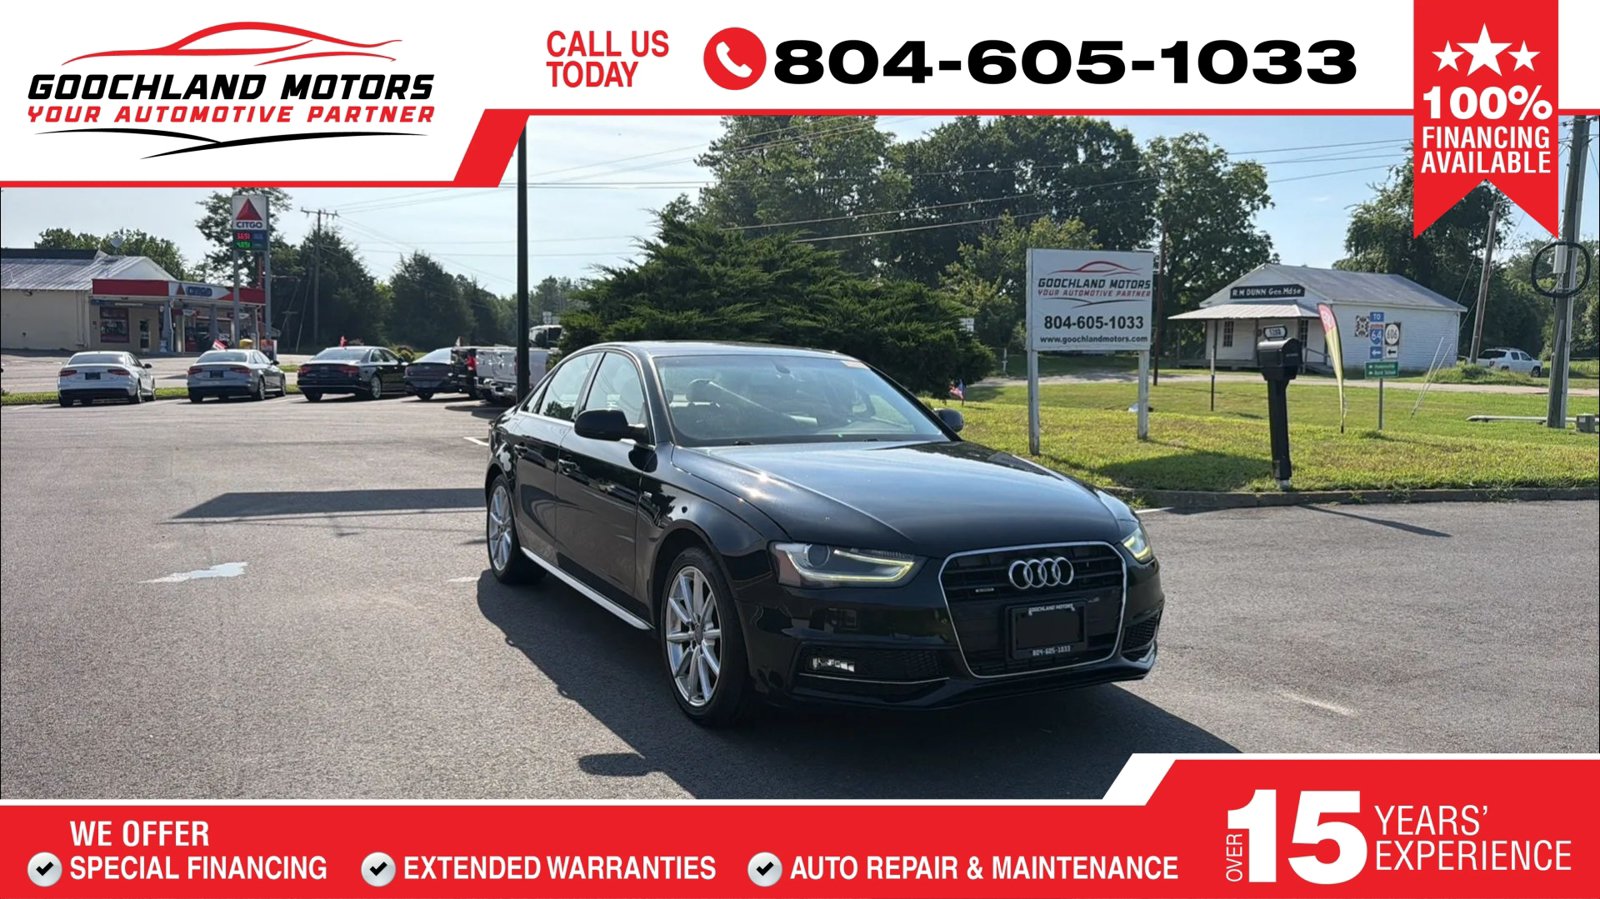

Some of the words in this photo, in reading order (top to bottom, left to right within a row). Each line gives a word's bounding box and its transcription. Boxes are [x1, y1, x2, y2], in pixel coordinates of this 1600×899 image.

[236, 221, 263, 229] CITGO
[1037, 278, 1105, 288] GOOCHLAND
[1109, 279, 1151, 289] MOTORS
[1037, 289, 1059, 297] YOUR
[1062, 289, 1112, 297] AUTOMOTIVE
[1246, 288, 1267, 296] DUNN
[1044, 315, 1144, 329] 804-605-1033
[1040, 335, 1148, 344] www.goochlandmotors.com
[1371, 330, 1382, 340] 64
